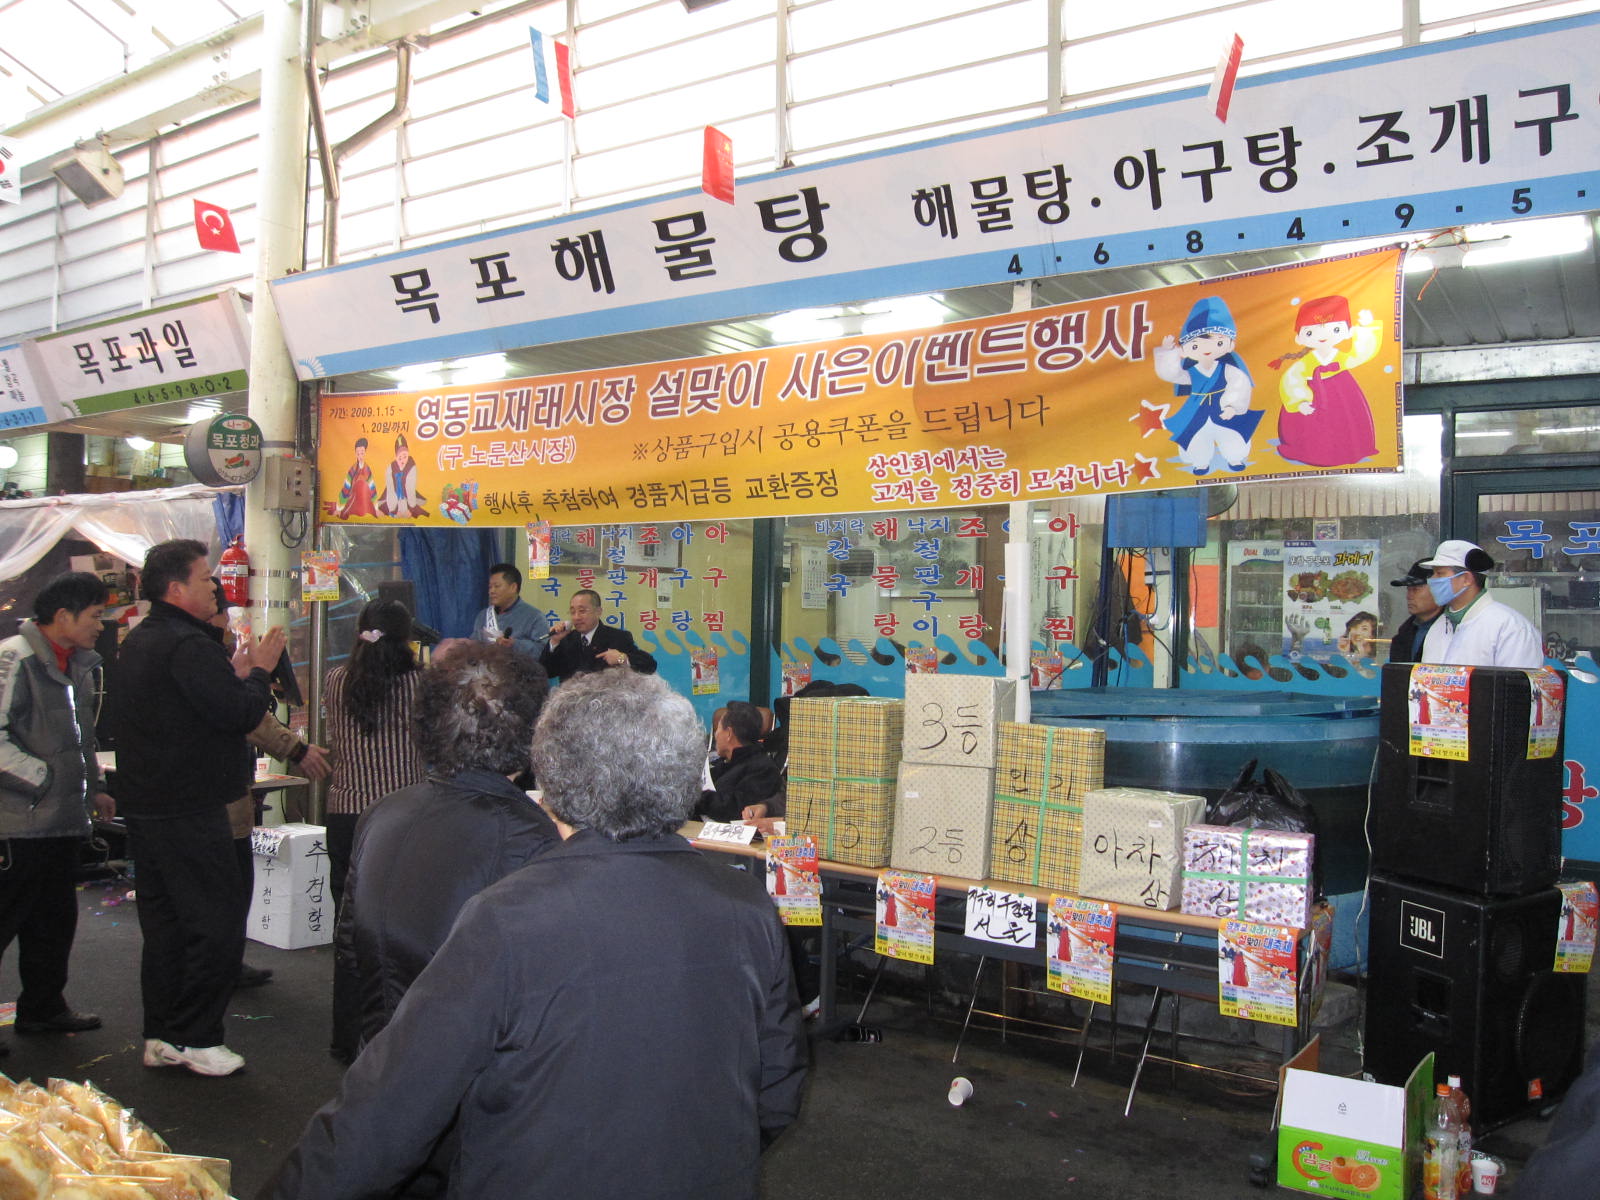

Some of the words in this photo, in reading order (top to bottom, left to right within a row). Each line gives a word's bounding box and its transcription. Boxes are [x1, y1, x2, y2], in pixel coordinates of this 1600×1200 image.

[73, 319, 197, 384] 목포과일
[415, 374, 635, 440] 영동교재래시장
[649, 358, 769, 418] 설맞이
[779, 303, 1151, 400] 사은이벤트행사
[328, 406, 349, 419] 기간:
[350, 405, 396, 418] 2009.1.15
[773, 409, 912, 452] 공용쿠폰을
[921, 395, 1050, 436] 드립니다
[212, 432, 260, 449] 목포청과
[437, 437, 576, 471] (구.노룬산시장)
[867, 446, 1006, 478] 상인회에서는
[484, 490, 534, 516] 행사후
[543, 486, 619, 514] 추첨하여
[625, 476, 732, 510] 경품지급등
[745, 469, 839, 500] 교환증정
[872, 477, 940, 503] 고객을
[952, 474, 1020, 500] 정중히
[1030, 460, 1132, 493] 모십니다
[601, 526, 633, 541] 낙지
[816, 519, 865, 535] 바지락
[907, 516, 949, 533] 낙지
[1333, 551, 1375, 567] 과메기
[920, 702, 983, 755] 3등
[1009, 764, 1075, 801] 인기
[909, 825, 965, 864] 2등
[1004, 818, 1037, 863] 상
[1094, 828, 1161, 875] 아차
[305, 840, 329, 932] 추첨함
[1140, 878, 1170, 908] 상
[1410, 915, 1436, 943] JBL
